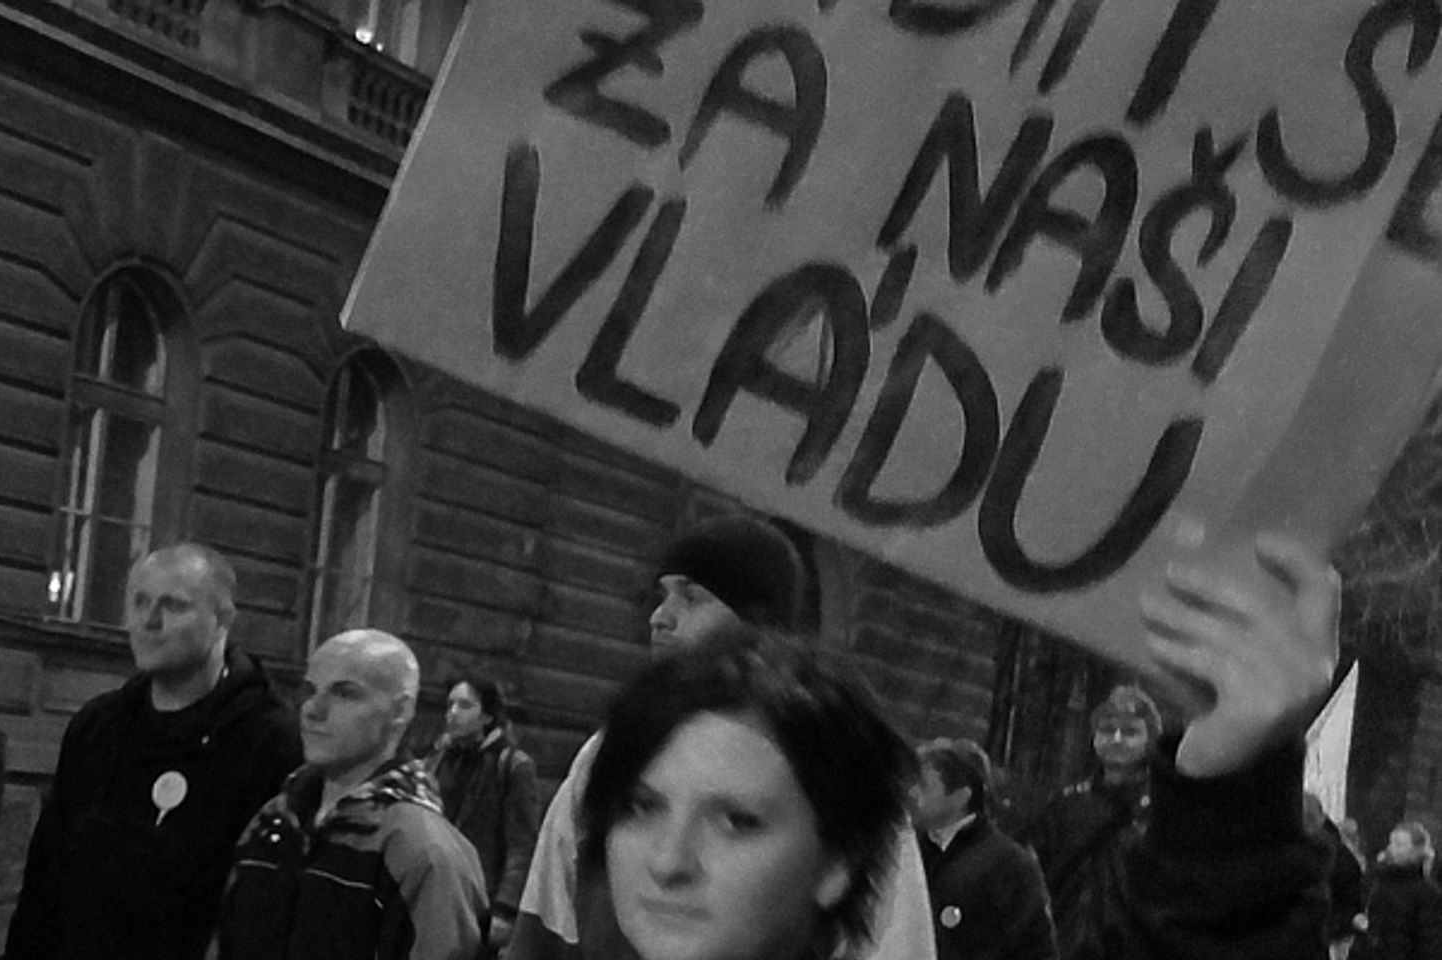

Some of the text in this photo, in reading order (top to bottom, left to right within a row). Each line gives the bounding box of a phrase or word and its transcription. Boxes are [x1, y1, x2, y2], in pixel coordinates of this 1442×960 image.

[875, 90, 1294, 386] NAŠI
[1256, 0, 1442, 262] S
[490, 138, 1204, 594] VLÁDU
